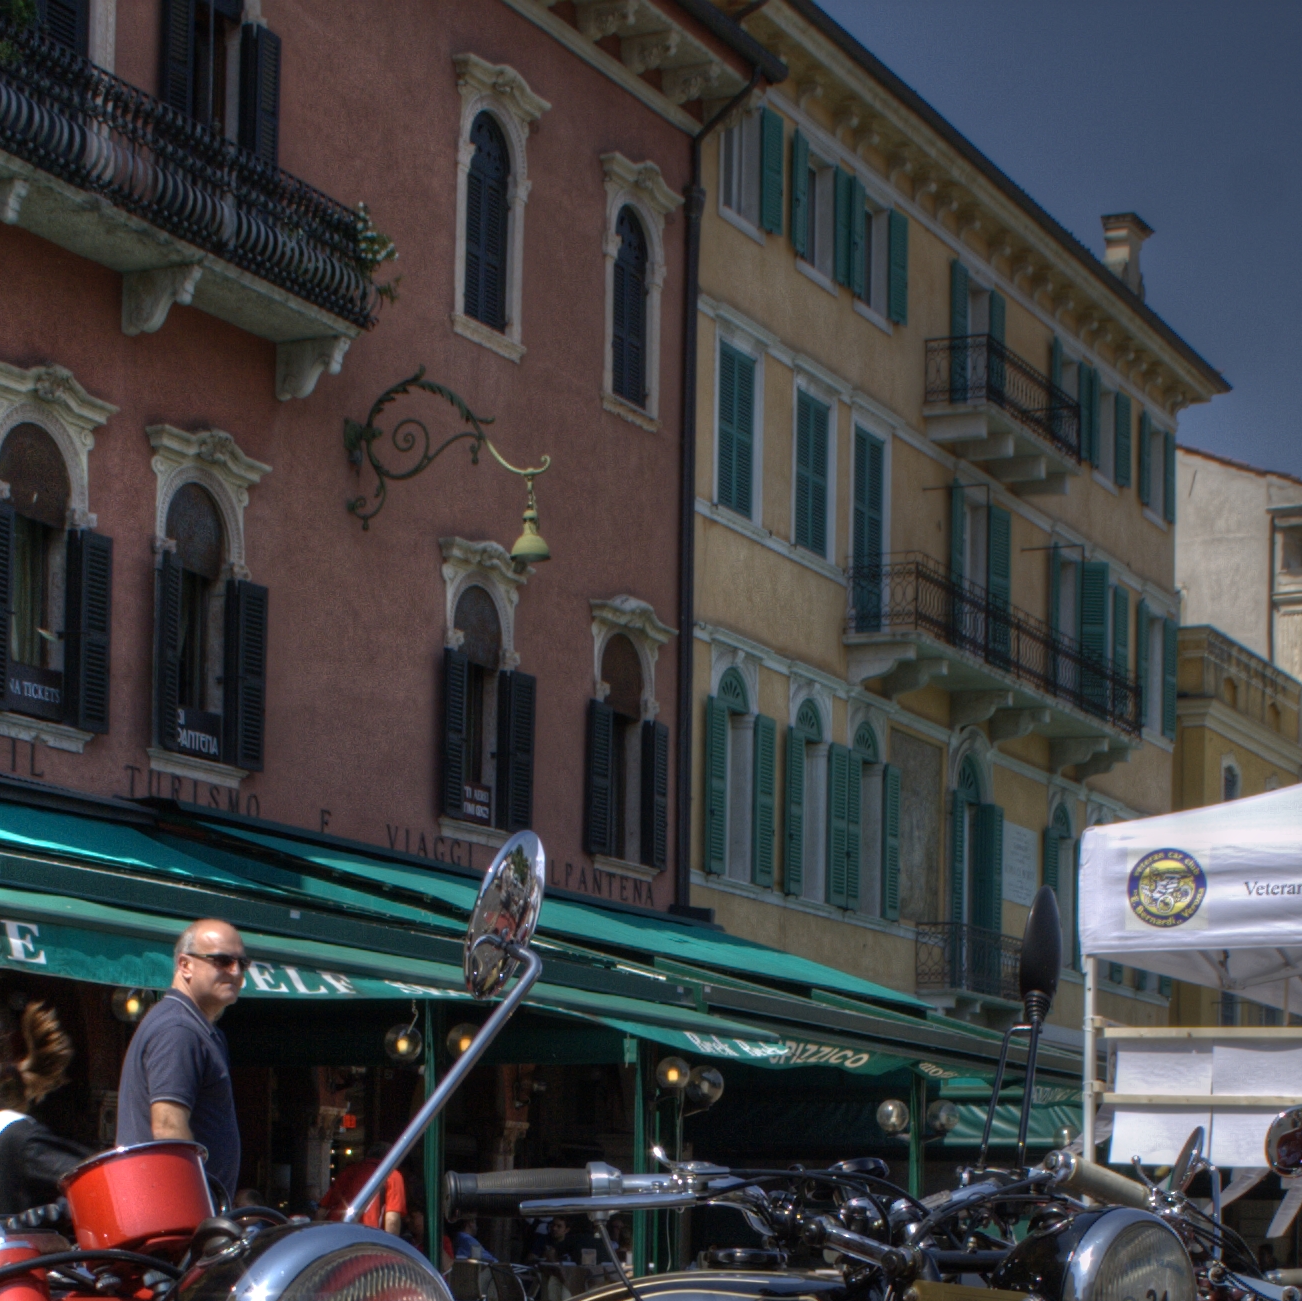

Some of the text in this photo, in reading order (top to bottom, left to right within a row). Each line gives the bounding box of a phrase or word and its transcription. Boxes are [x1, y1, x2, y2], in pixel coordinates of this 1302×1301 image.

[22, 681, 61, 704] TICKETS
[10, 738, 45, 778] IL
[386, 823, 474, 870] VIAGGI
[550, 859, 655, 907] LPANTENA
[1167, 851, 1184, 860] car
[1183, 858, 1200, 876] club
[240, 960, 357, 995] ELF
